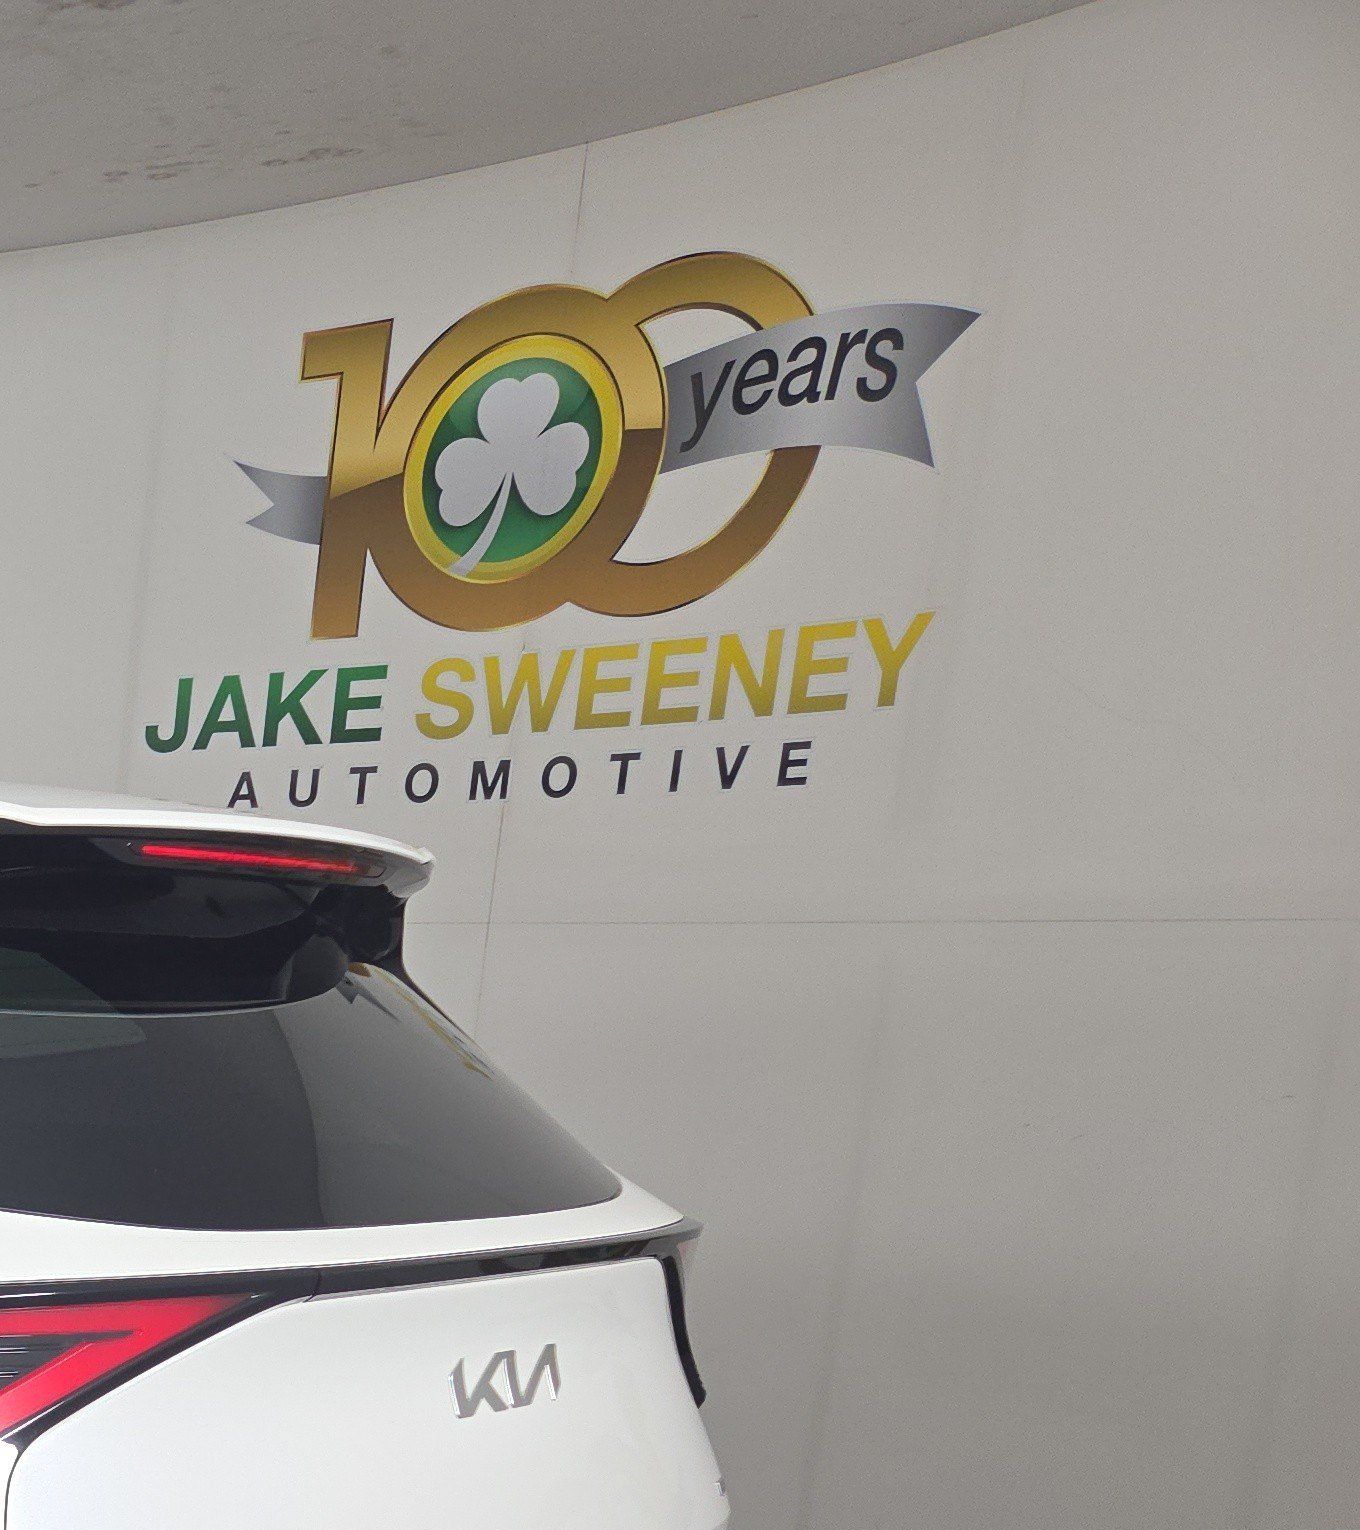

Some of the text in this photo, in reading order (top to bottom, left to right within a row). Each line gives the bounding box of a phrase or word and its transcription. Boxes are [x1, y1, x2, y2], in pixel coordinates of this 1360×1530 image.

[682, 325, 904, 452] years
[144, 611, 936, 753] JAKE SWEENEY
[228, 740, 814, 809] AUTOMOTIVE
[447, 1343, 561, 1419] KIA
